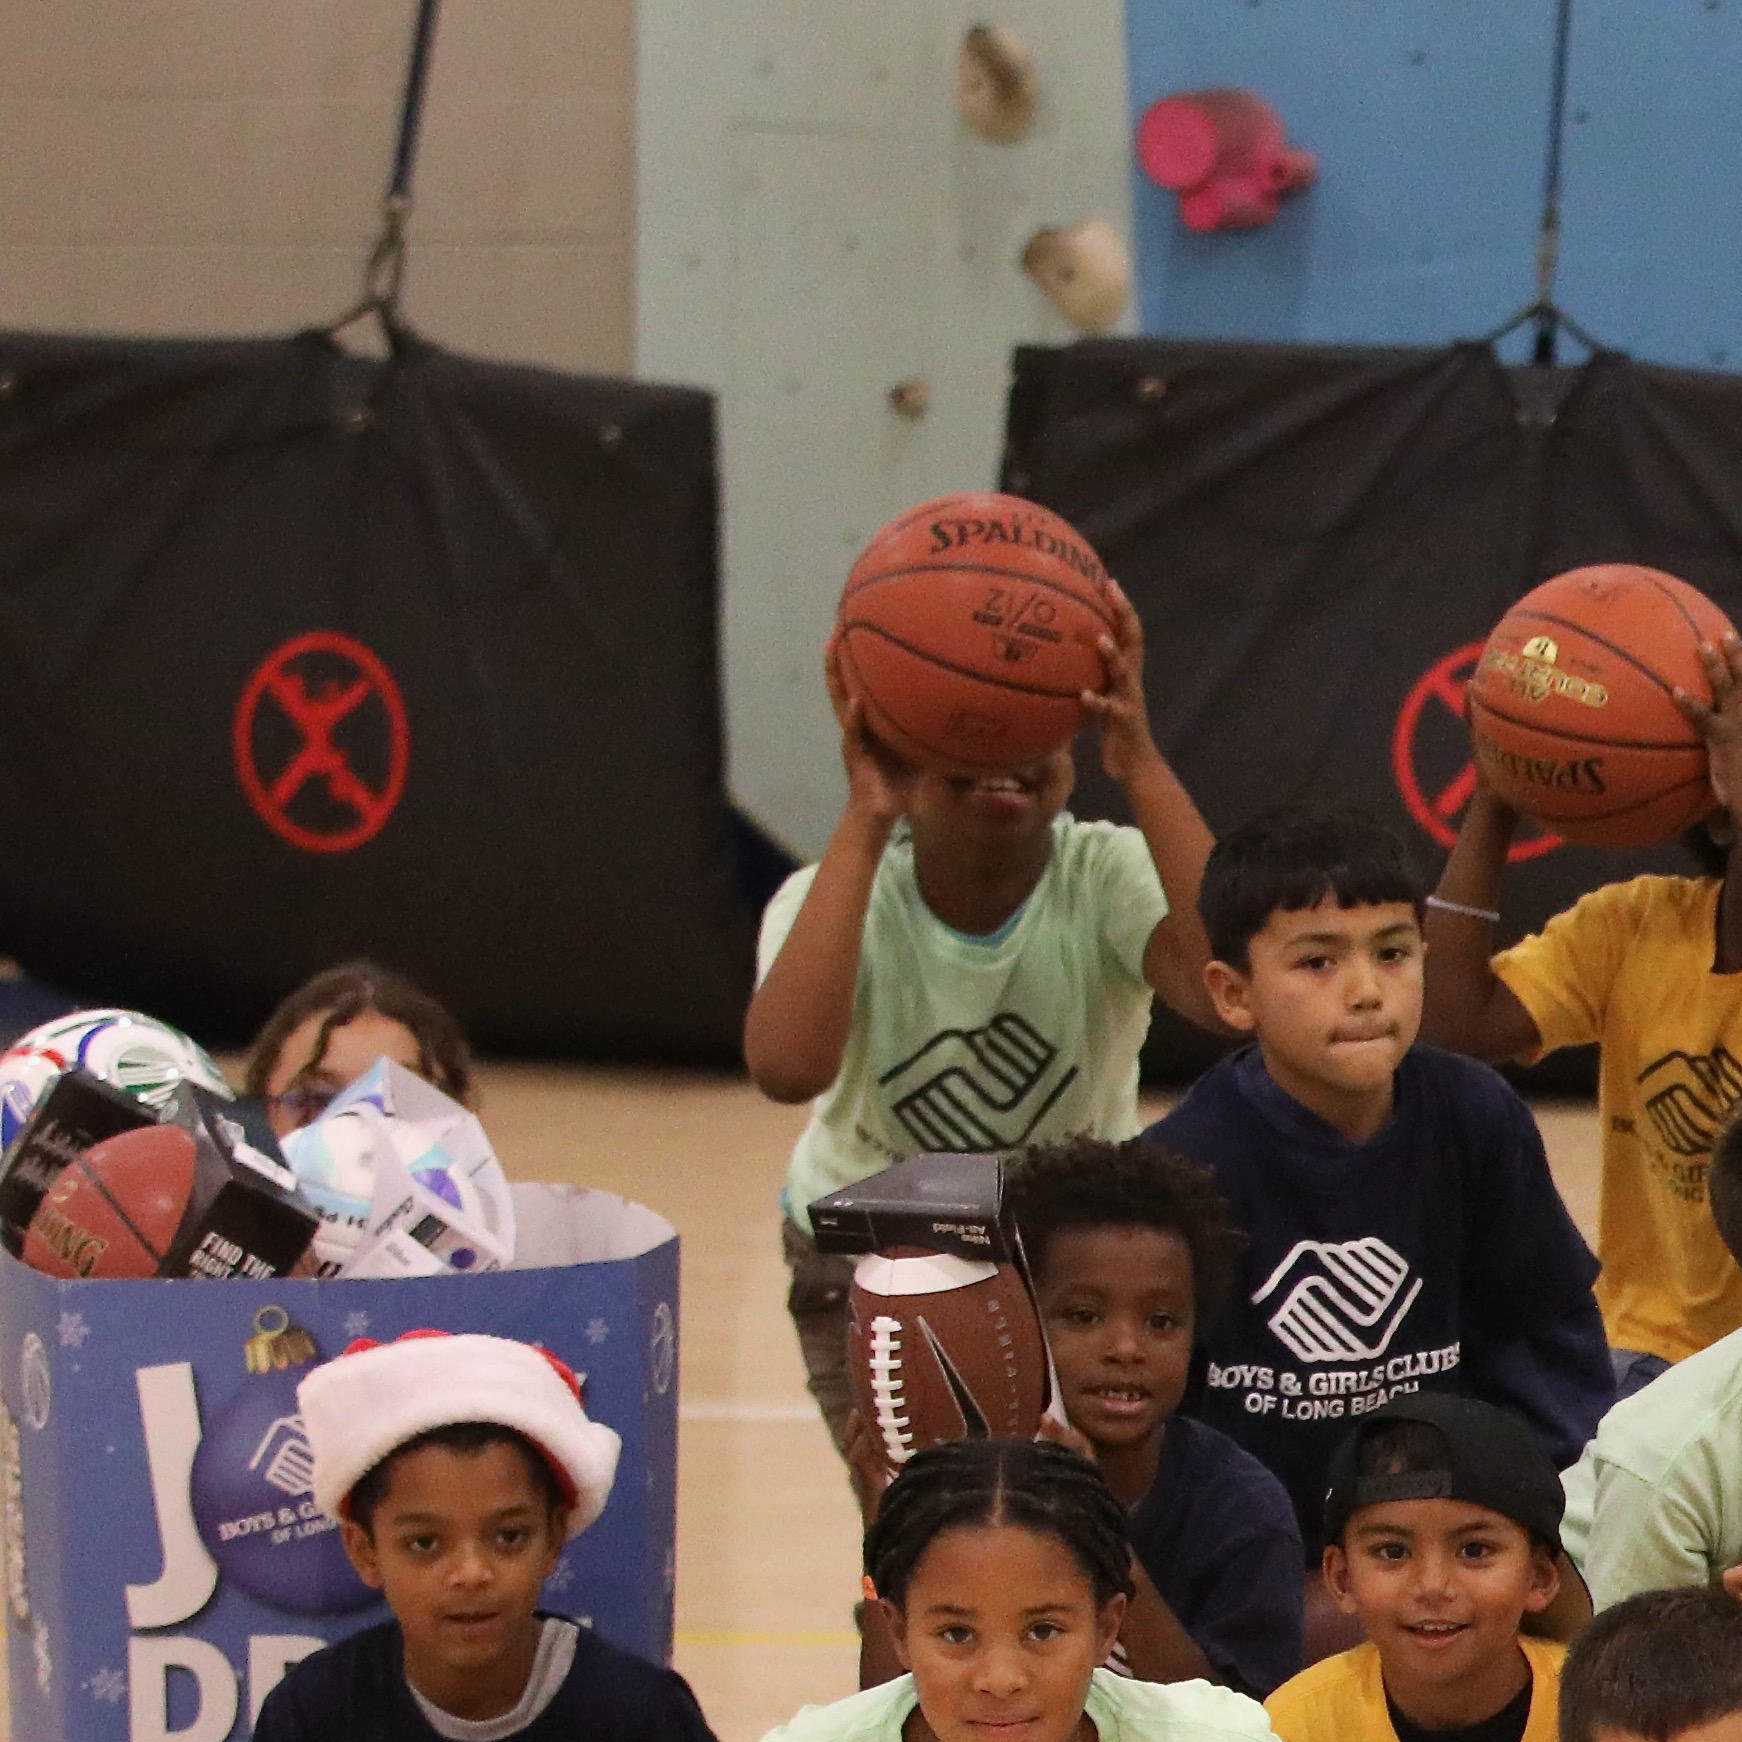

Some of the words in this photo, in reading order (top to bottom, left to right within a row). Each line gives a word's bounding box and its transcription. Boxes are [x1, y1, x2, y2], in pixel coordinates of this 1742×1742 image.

[1207, 1362, 1274, 1391] BOYS
[1279, 1372, 1304, 1397] &
[1308, 1364, 1386, 1396] GIRLS
[1244, 1391, 1278, 1415] OF
[1281, 1397, 1346, 1422] LONG
[219, 1511, 276, 1542] BOYS
[277, 1507, 297, 1526] &
